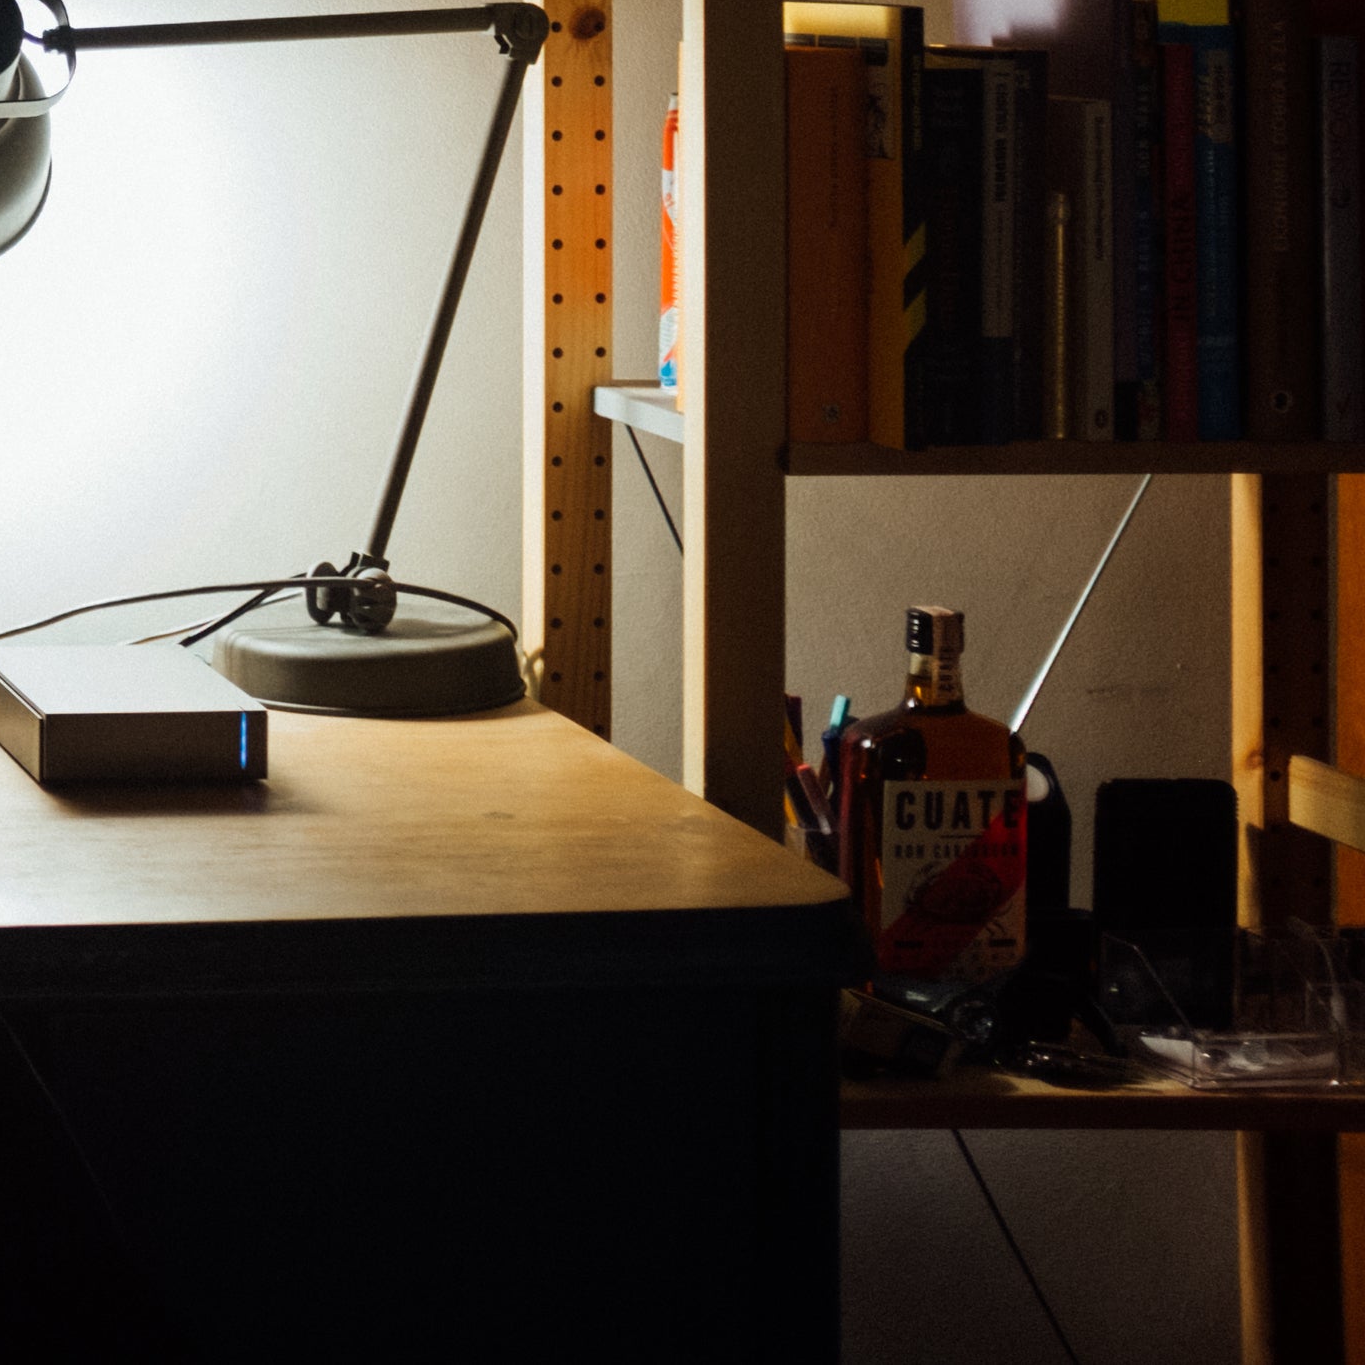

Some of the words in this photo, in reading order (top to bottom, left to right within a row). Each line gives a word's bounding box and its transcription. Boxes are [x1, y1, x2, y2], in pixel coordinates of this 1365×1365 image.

[1271, 20, 1287, 56] ZLA
[1271, 79, 1288, 145] DOBRA
[1330, 61, 1351, 173] REWORK
[1173, 190, 1192, 284] CHINA
[895, 790, 1020, 831] CUATE
